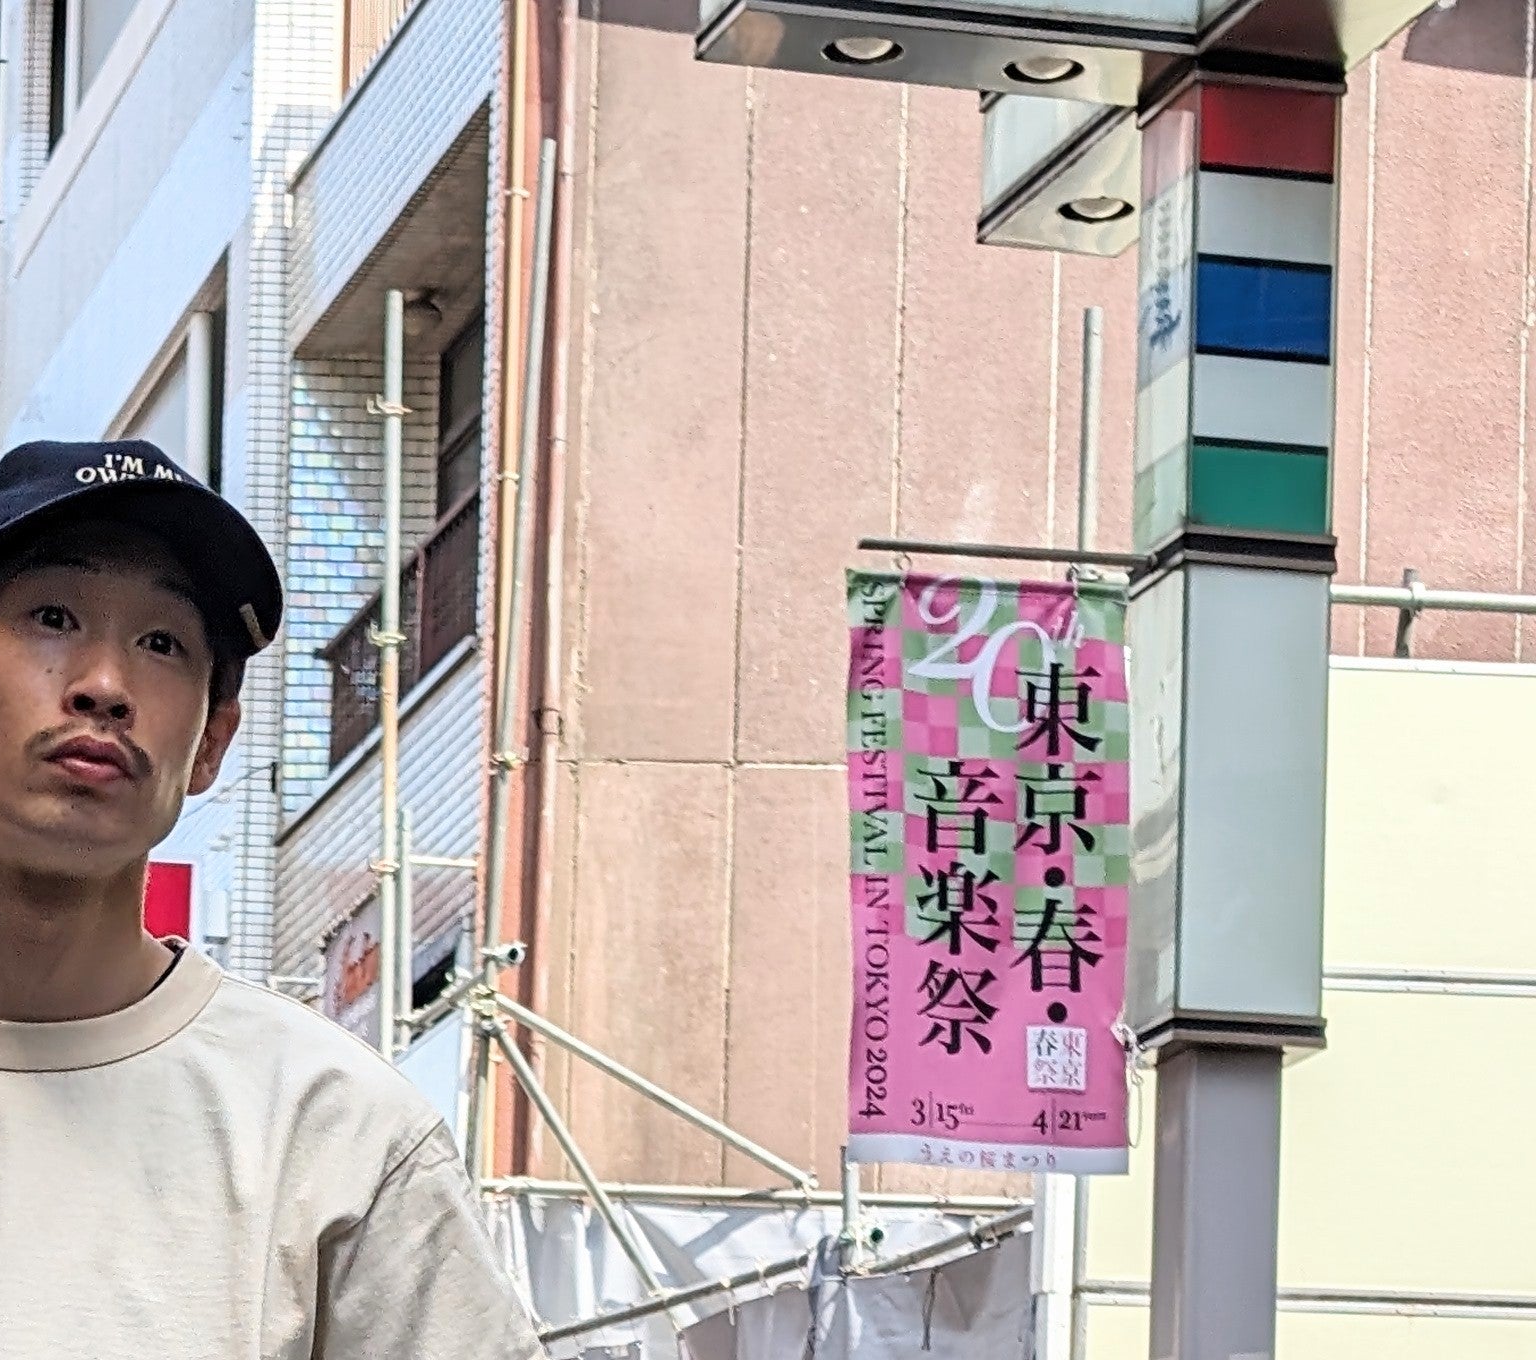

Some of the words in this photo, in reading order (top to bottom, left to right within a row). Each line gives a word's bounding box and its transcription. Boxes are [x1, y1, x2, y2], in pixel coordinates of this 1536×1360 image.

[104, 454, 144, 475] I'M
[154, 464, 182, 481] M
[861, 582, 885, 700] SPRING
[861, 711, 888, 866] FESTIVAL
[865, 876, 889, 909] IN
[914, 760, 1004, 1056] 音楽祭
[865, 919, 889, 1041] TOKYO
[859, 1048, 888, 1118] 2024
